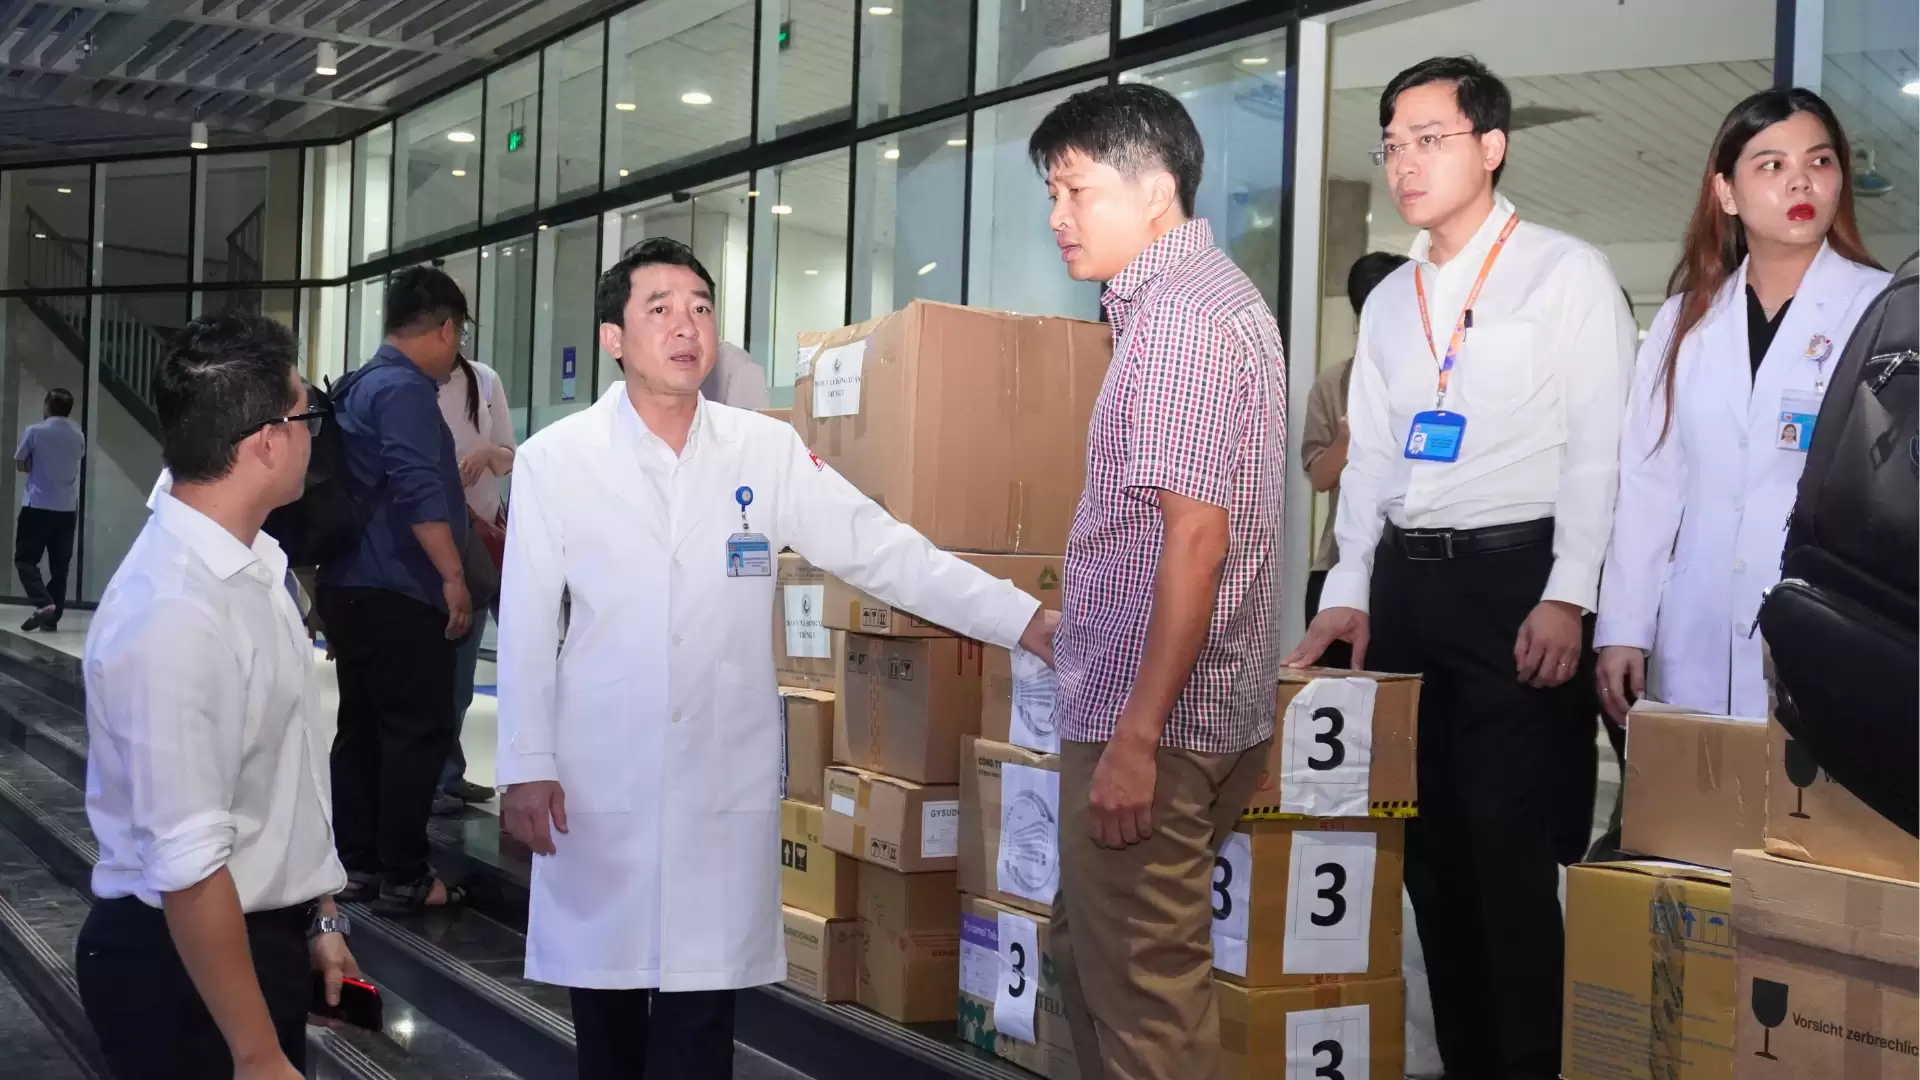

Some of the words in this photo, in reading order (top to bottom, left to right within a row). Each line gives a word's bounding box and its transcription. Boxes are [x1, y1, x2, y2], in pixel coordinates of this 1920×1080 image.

[1307, 706, 1345, 771] 3
[1211, 856, 1233, 921] 3
[1310, 862, 1347, 927] 3
[1008, 942, 1026, 998] 3
[1792, 1012, 1844, 1038] Vorsicht
[1312, 1039, 1345, 1080] 3
